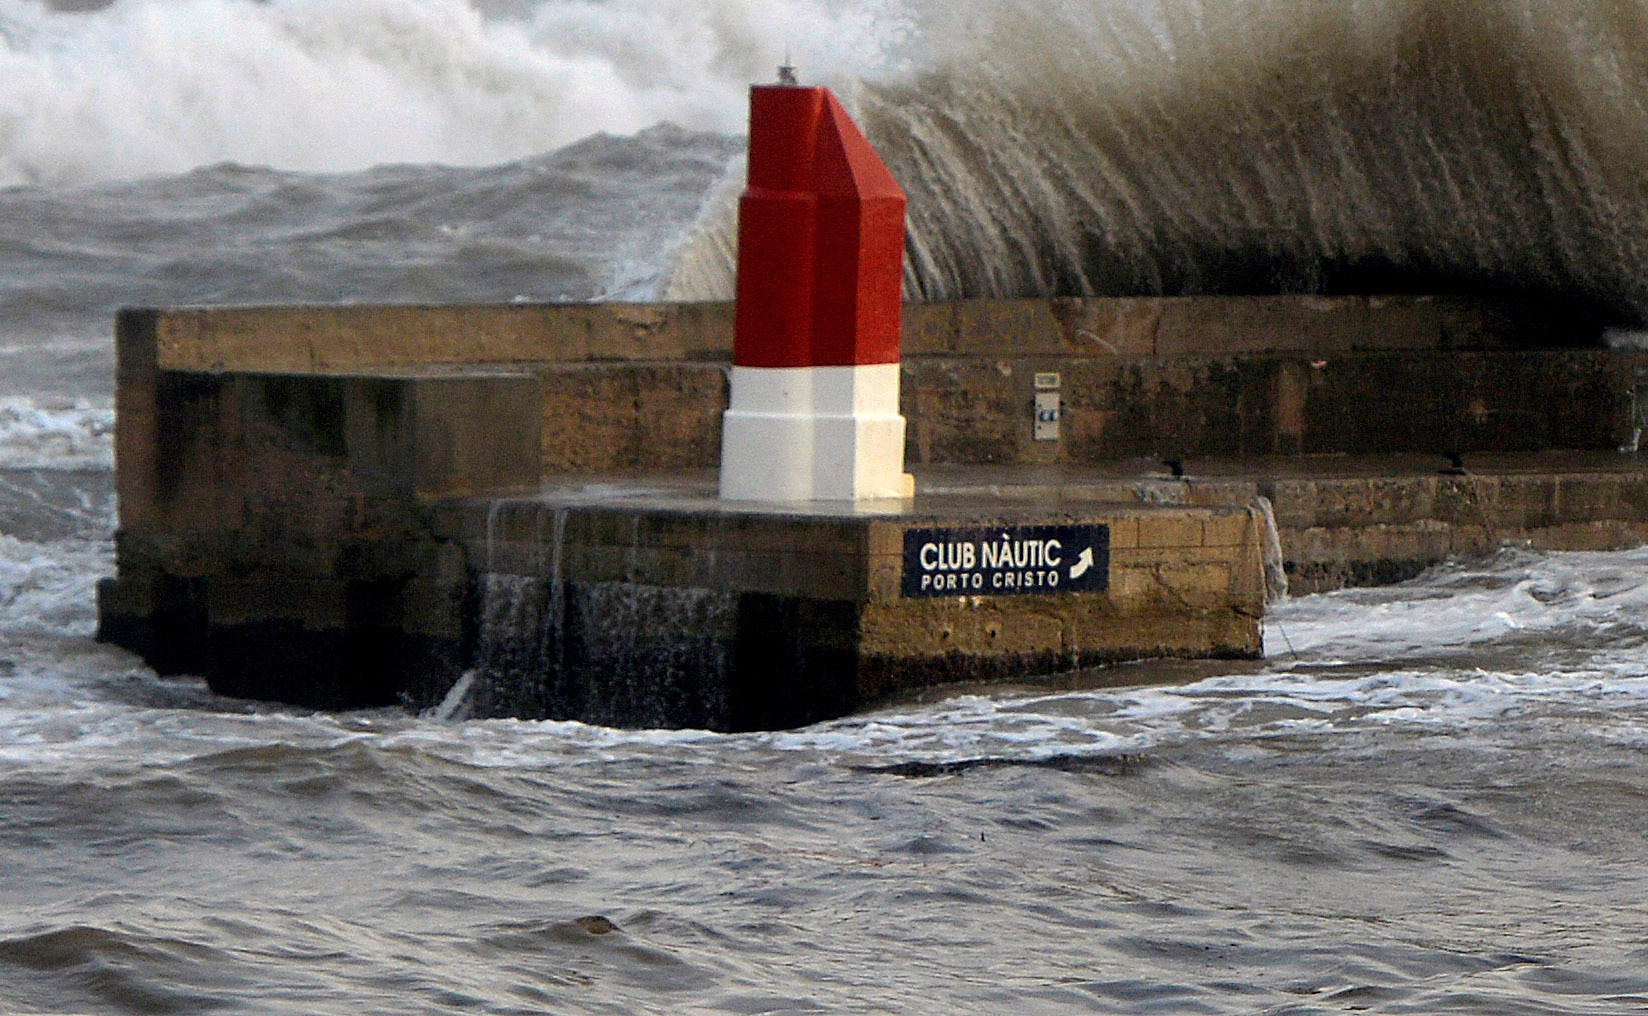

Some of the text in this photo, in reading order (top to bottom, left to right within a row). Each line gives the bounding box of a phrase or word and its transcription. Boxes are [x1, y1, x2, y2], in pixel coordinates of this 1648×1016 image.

[920, 533, 1062, 570] CLUB NÀUTIC
[921, 570, 1059, 590] PORTO CRISTO
